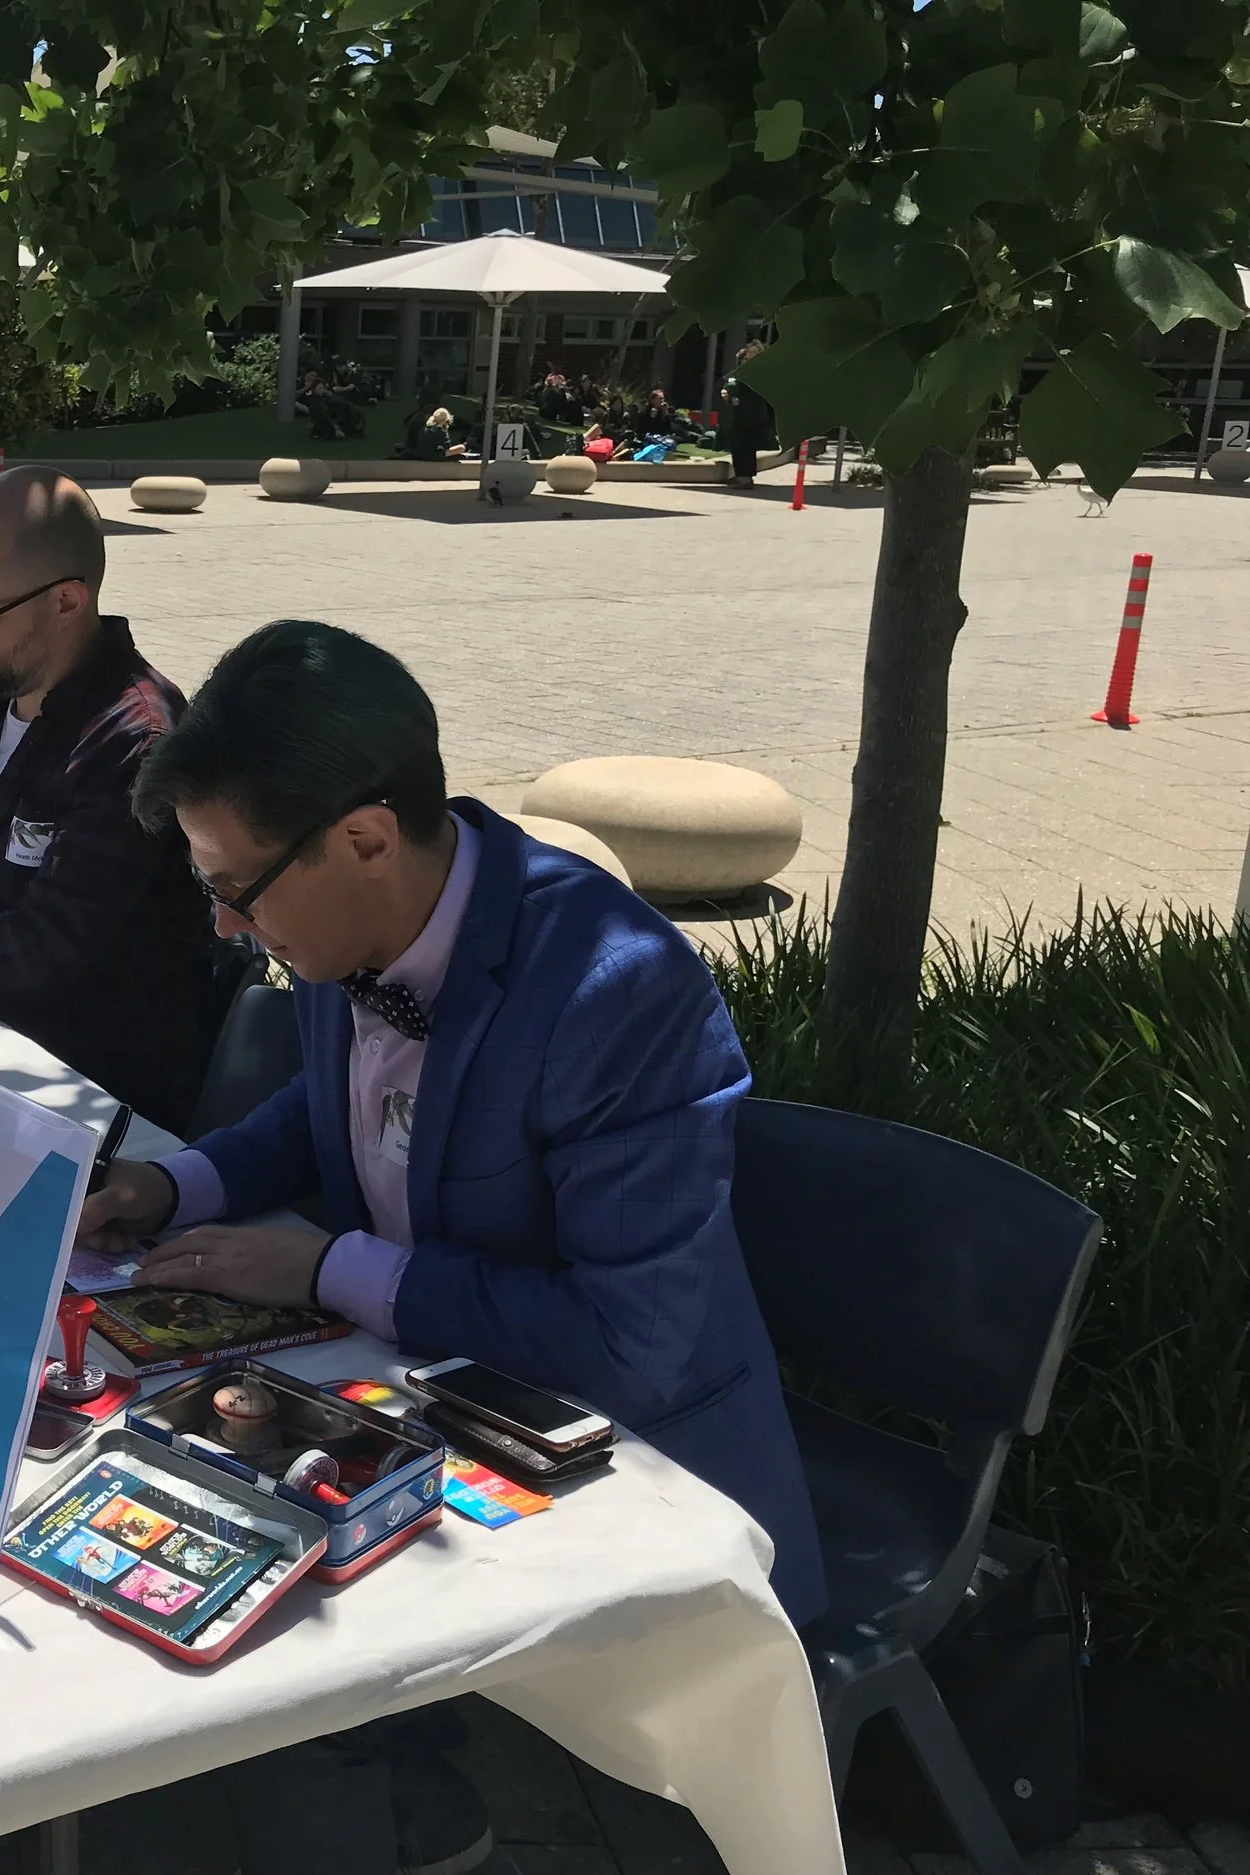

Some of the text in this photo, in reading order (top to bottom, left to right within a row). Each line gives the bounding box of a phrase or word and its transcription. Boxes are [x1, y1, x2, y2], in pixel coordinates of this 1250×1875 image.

[500, 429, 519, 457] 4
[1226, 425, 1244, 447] 2
[202, 1351, 214, 1361] THE
[216, 1344, 249, 1359] TREASURE
[250, 1342, 260, 1351] OF
[260, 1339, 278, 1350] DEAD
[300, 1330, 318, 1341] COVE
[28, 1519, 77, 1558] OTHER
[73, 1480, 123, 1521] WORLD
